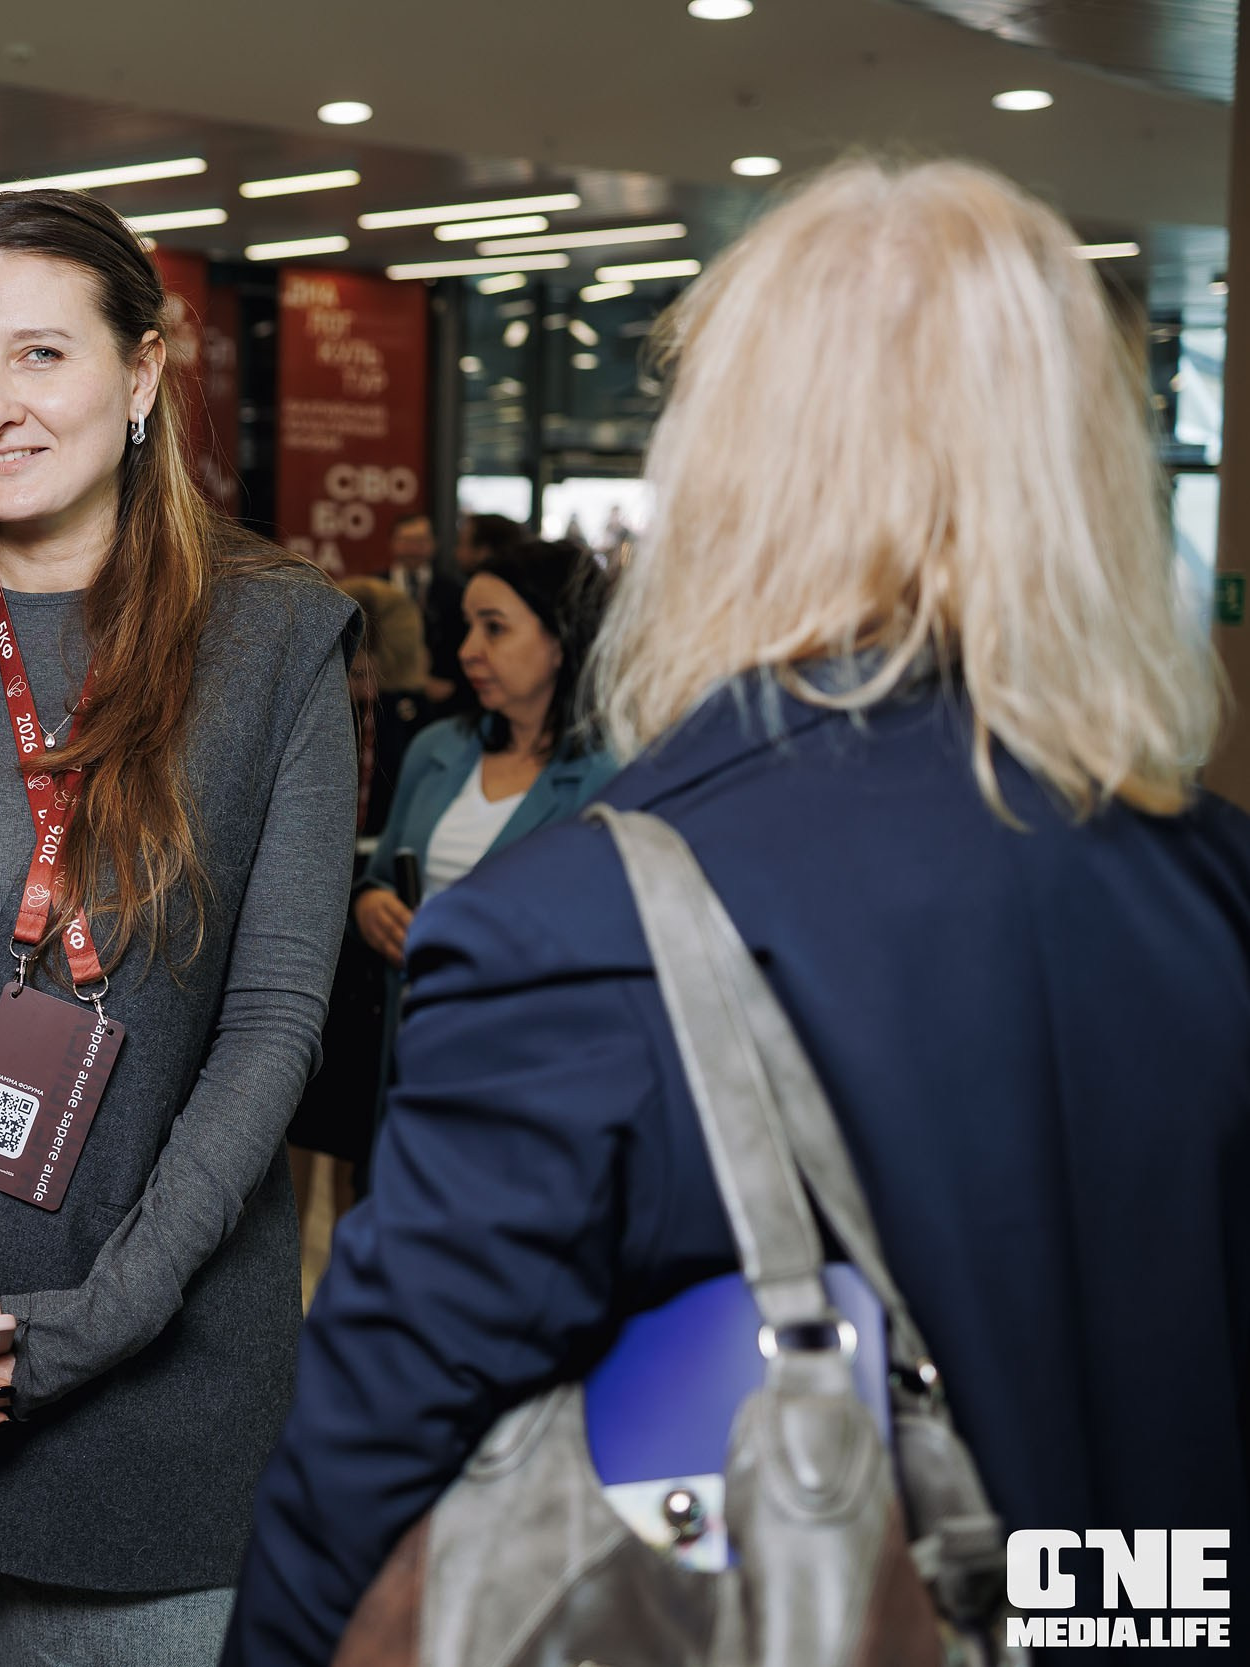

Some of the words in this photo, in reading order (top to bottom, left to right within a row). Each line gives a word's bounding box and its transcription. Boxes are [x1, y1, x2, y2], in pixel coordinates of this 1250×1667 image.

[325, 464, 419, 505] СВО
[310, 501, 375, 541] БО
[16, 713, 38, 754] 2026
[39, 824, 64, 866] 2026
[83, 1019, 108, 1068] sapere
[18, 1082, 44, 1096] ФОРУМА
[68, 1070, 89, 1108] aude
[48, 1111, 74, 1161] sapere
[33, 1164, 54, 1202] aude
